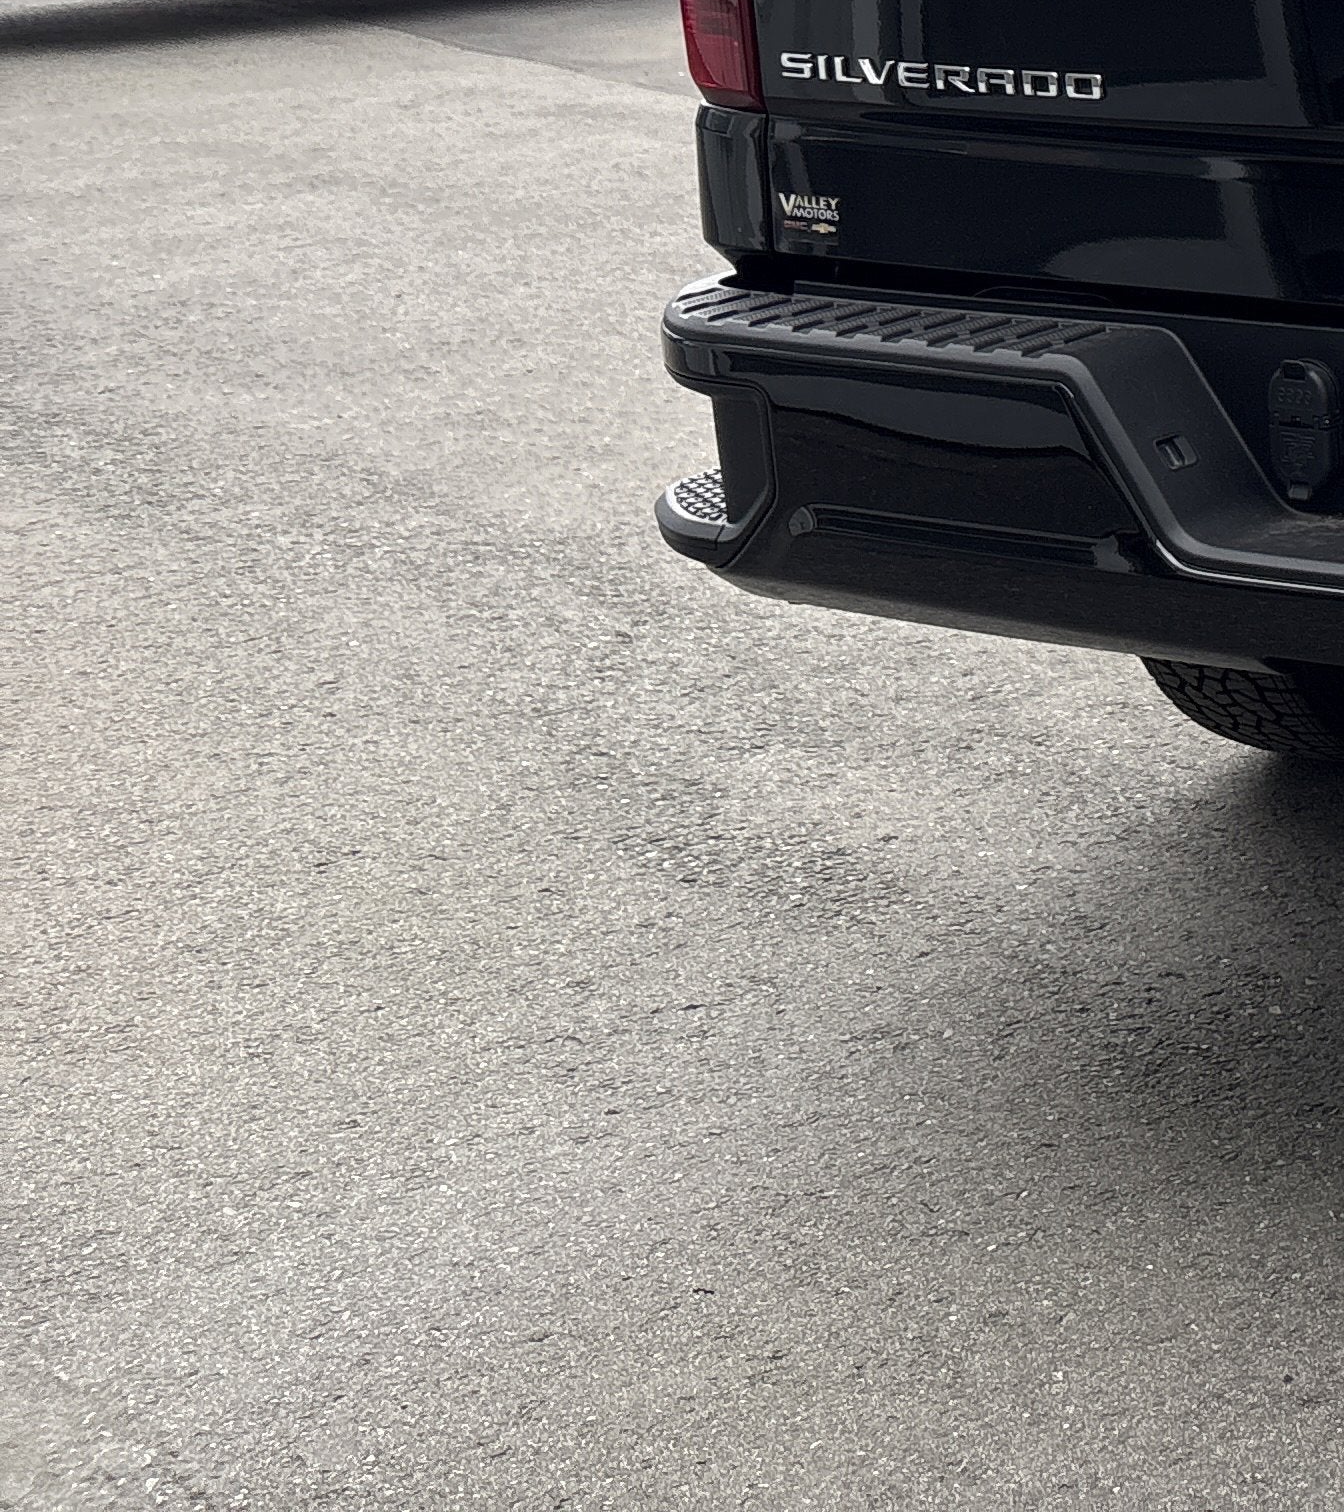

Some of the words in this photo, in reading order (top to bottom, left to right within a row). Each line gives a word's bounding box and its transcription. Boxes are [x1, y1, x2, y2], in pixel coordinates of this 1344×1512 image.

[780, 52, 1102, 100] SILVERADO
[778, 192, 840, 216] VALLEY
[792, 207, 840, 221] MOTORS
